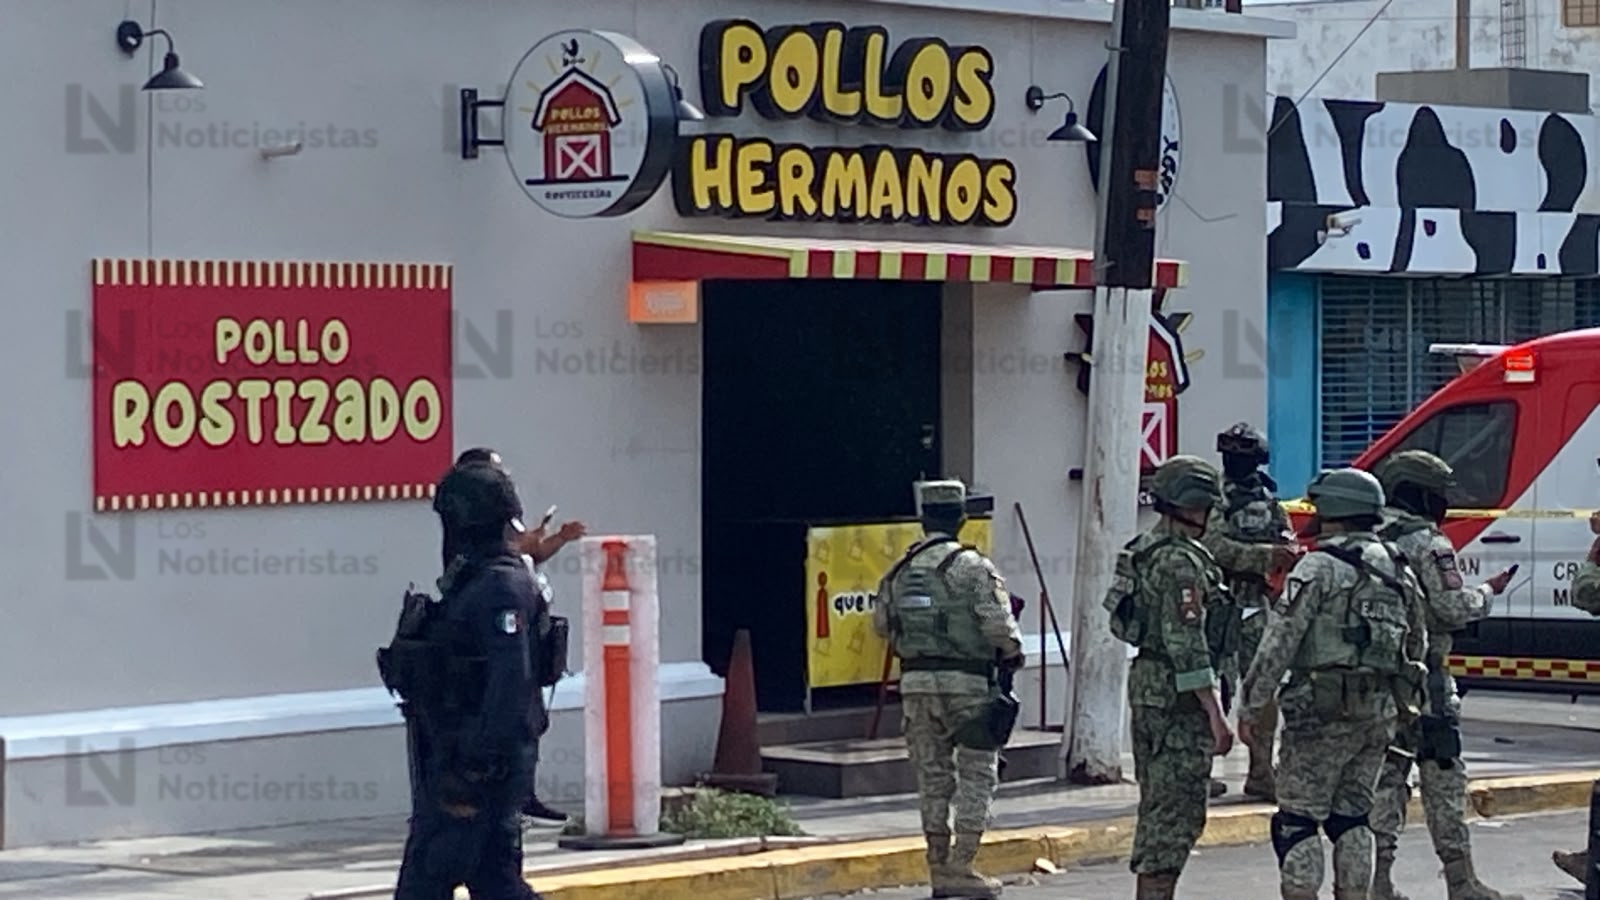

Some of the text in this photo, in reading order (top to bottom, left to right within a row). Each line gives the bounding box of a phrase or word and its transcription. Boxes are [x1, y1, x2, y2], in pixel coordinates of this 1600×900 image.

[720, 24, 994, 124] POLLOS
[691, 136, 1018, 224] HERMANOS
[216, 318, 349, 364] POLLO
[834, 594, 864, 616] que
